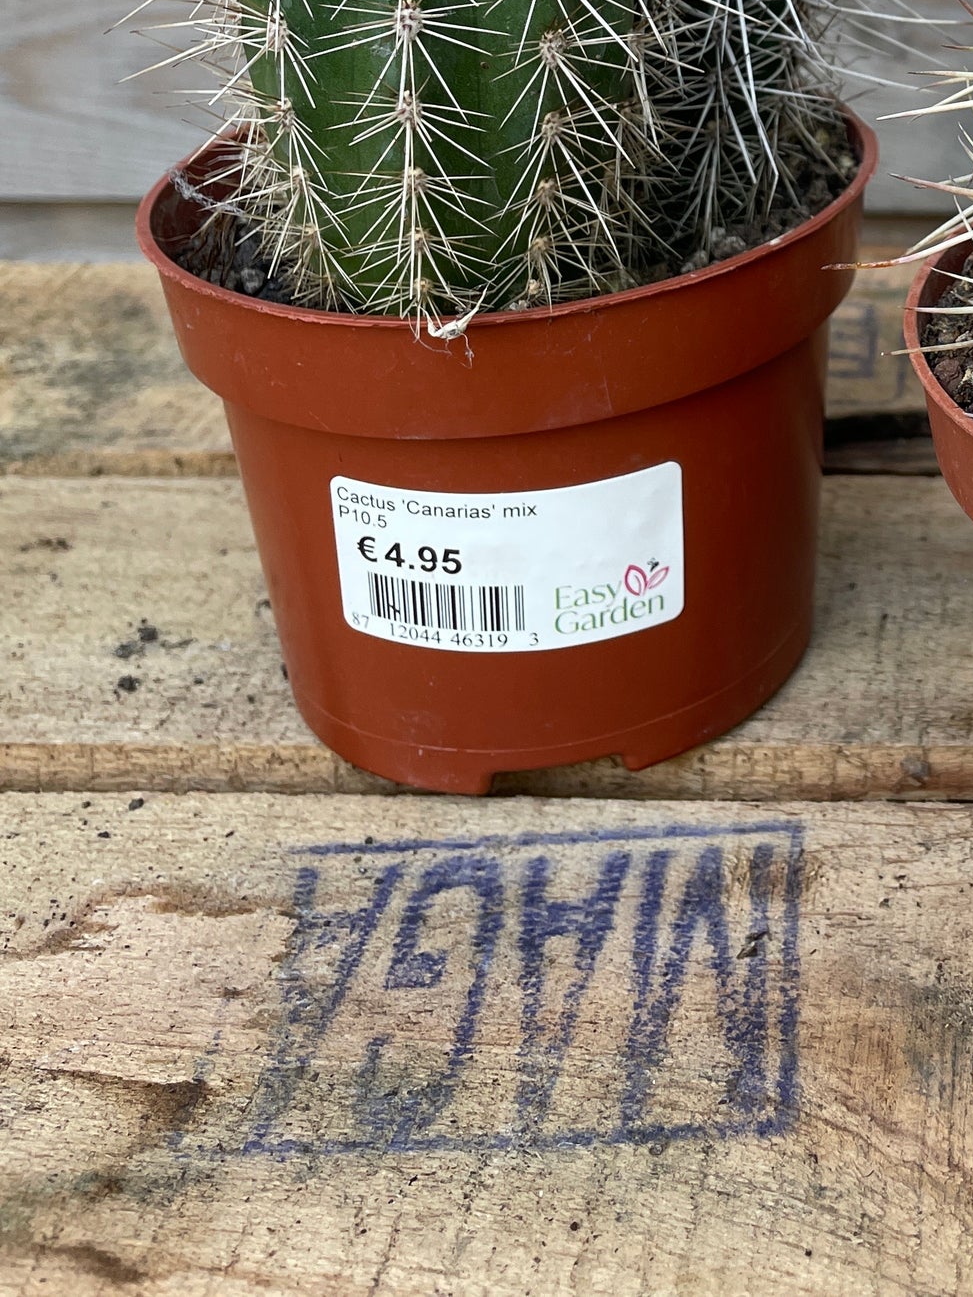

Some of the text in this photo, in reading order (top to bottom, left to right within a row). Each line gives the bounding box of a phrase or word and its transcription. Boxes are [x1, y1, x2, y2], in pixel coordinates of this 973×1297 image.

[337, 487, 537, 518] Cactus 'Canarias' mix
[339, 505, 387, 529] P10.5
[555, 581, 621, 610] Easy
[555, 593, 664, 635] Garden
[352, 613, 539, 647] 87 12044 46319 3
